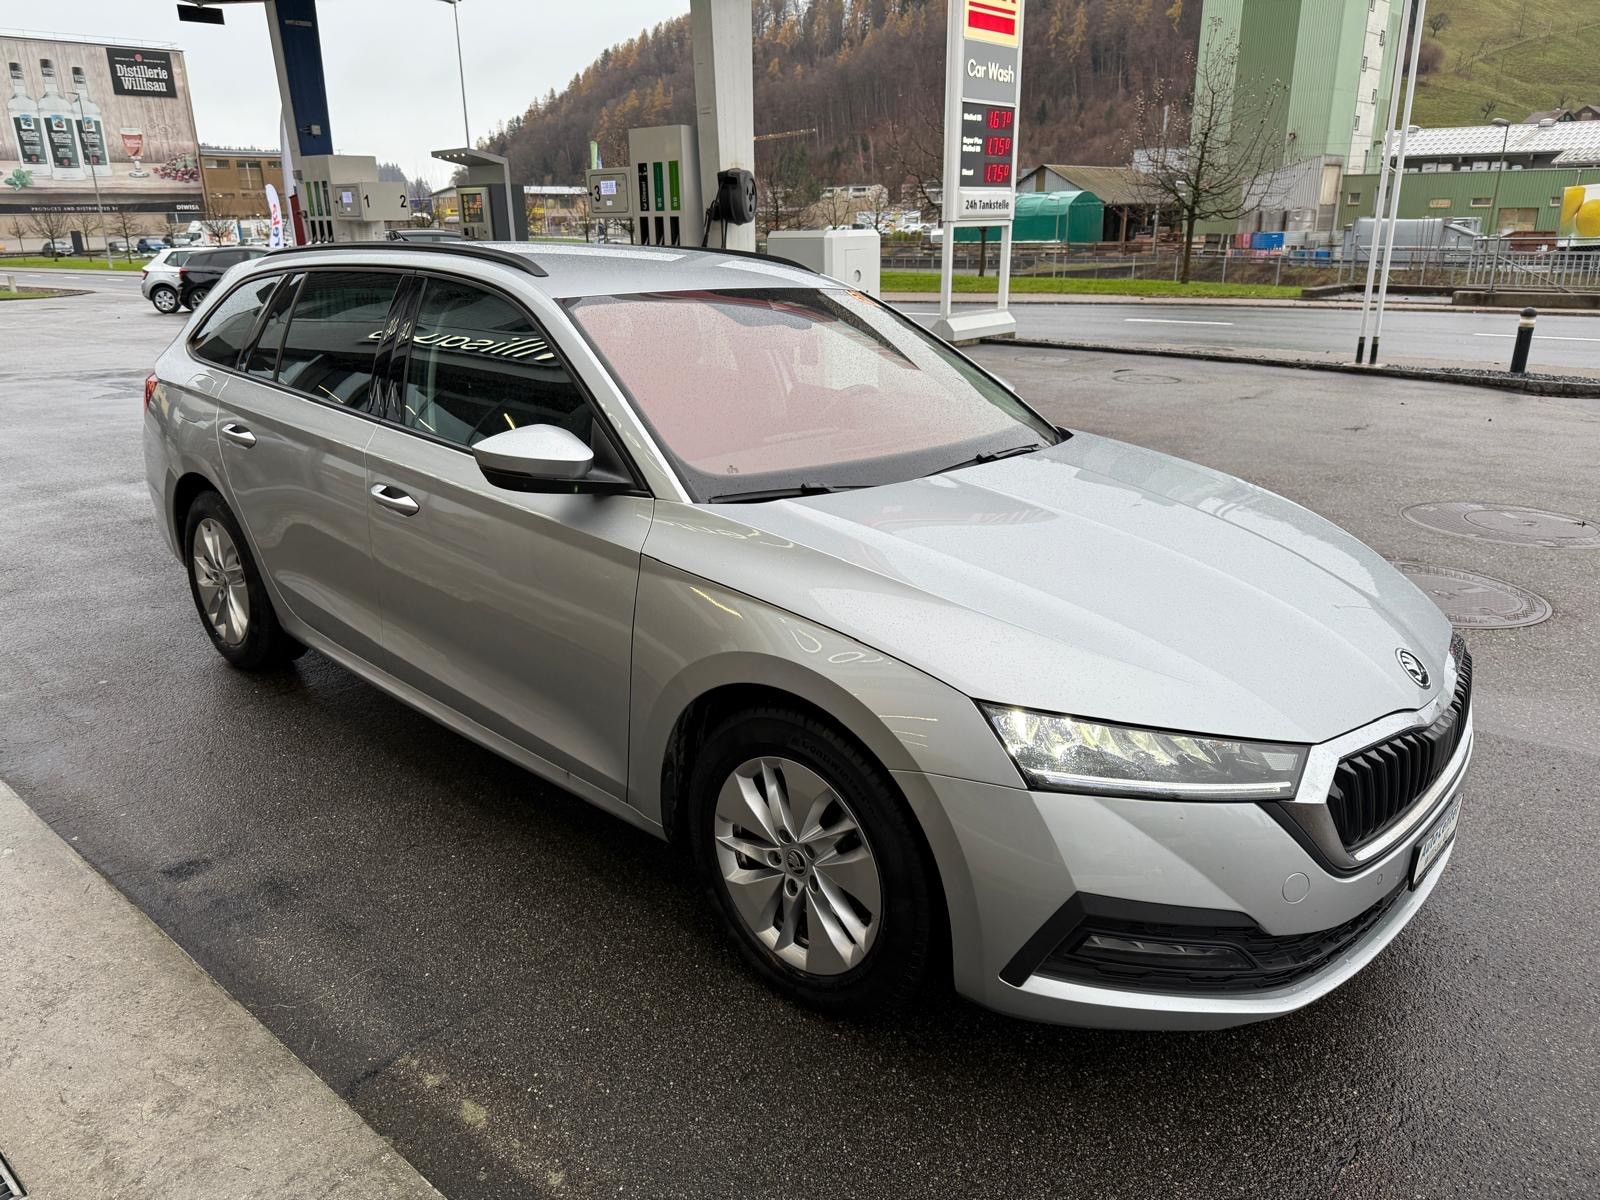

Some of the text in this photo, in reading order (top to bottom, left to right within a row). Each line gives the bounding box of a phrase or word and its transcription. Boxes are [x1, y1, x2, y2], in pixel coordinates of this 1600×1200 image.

[115, 64, 168, 79] Distillerie
[967, 58, 1014, 83] Car Wash
[120, 77, 167, 92] Willisau
[364, 194, 370, 208] 1
[400, 194, 407, 208] 2
[594, 185, 601, 202] 3
[965, 199, 1009, 210] 24h Tankstelle
